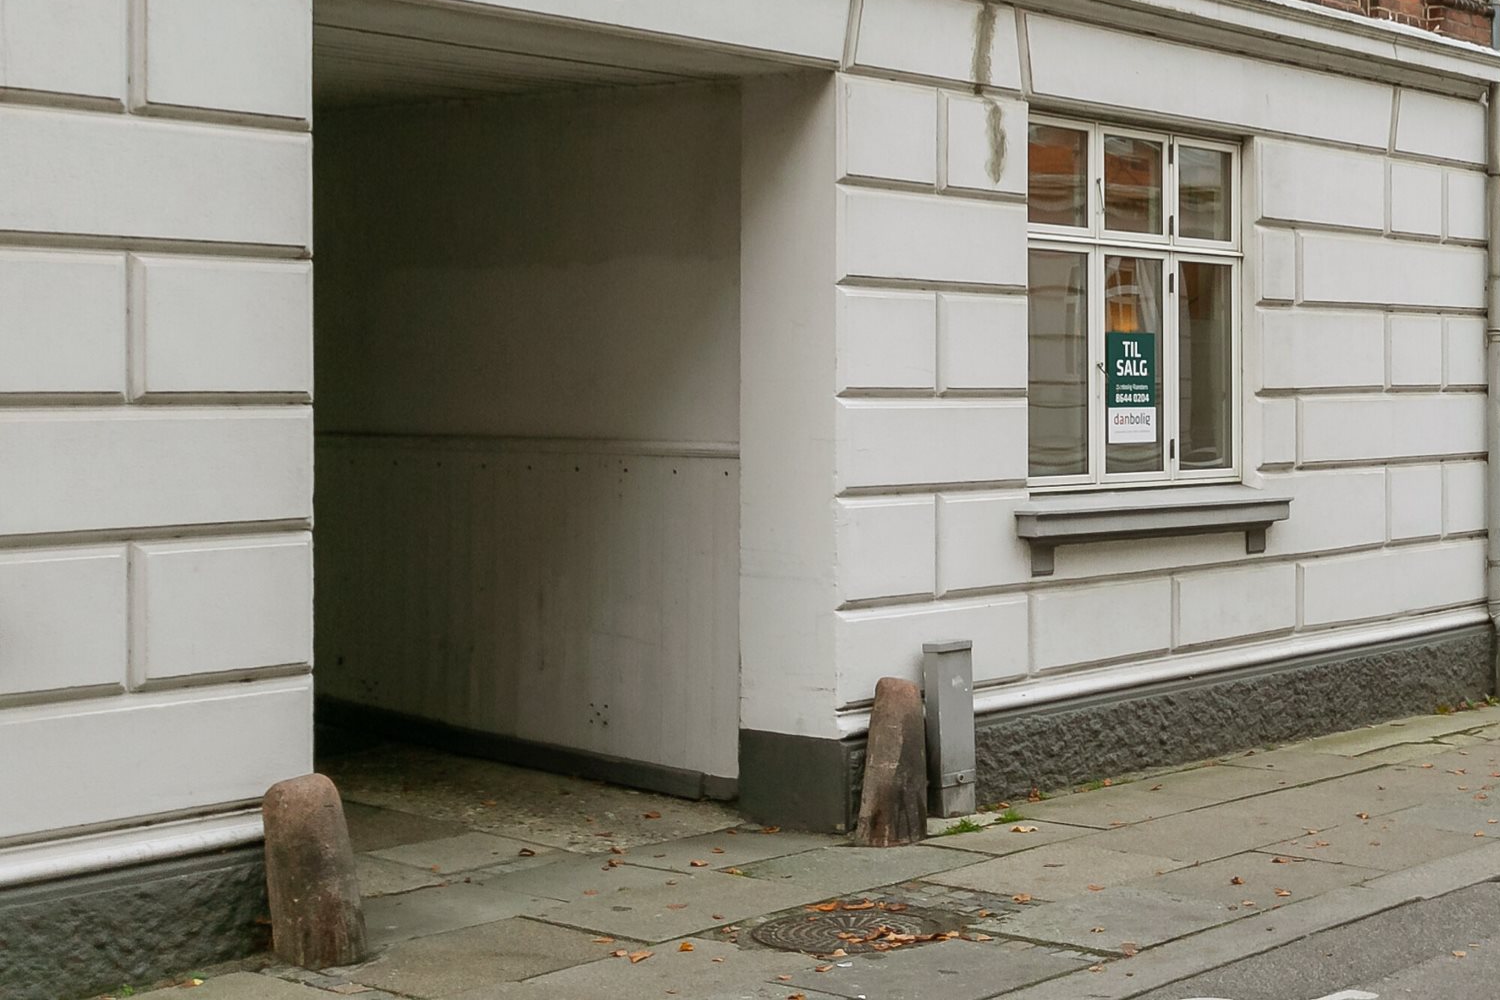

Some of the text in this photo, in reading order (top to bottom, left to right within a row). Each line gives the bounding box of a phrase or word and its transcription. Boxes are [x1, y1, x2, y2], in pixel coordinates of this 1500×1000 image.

[1122, 341, 1142, 358] TIL
[1116, 359, 1148, 376] SALG
[1115, 393, 1150, 403] 8644 0204
[1113, 412, 1151, 426] danbolig
